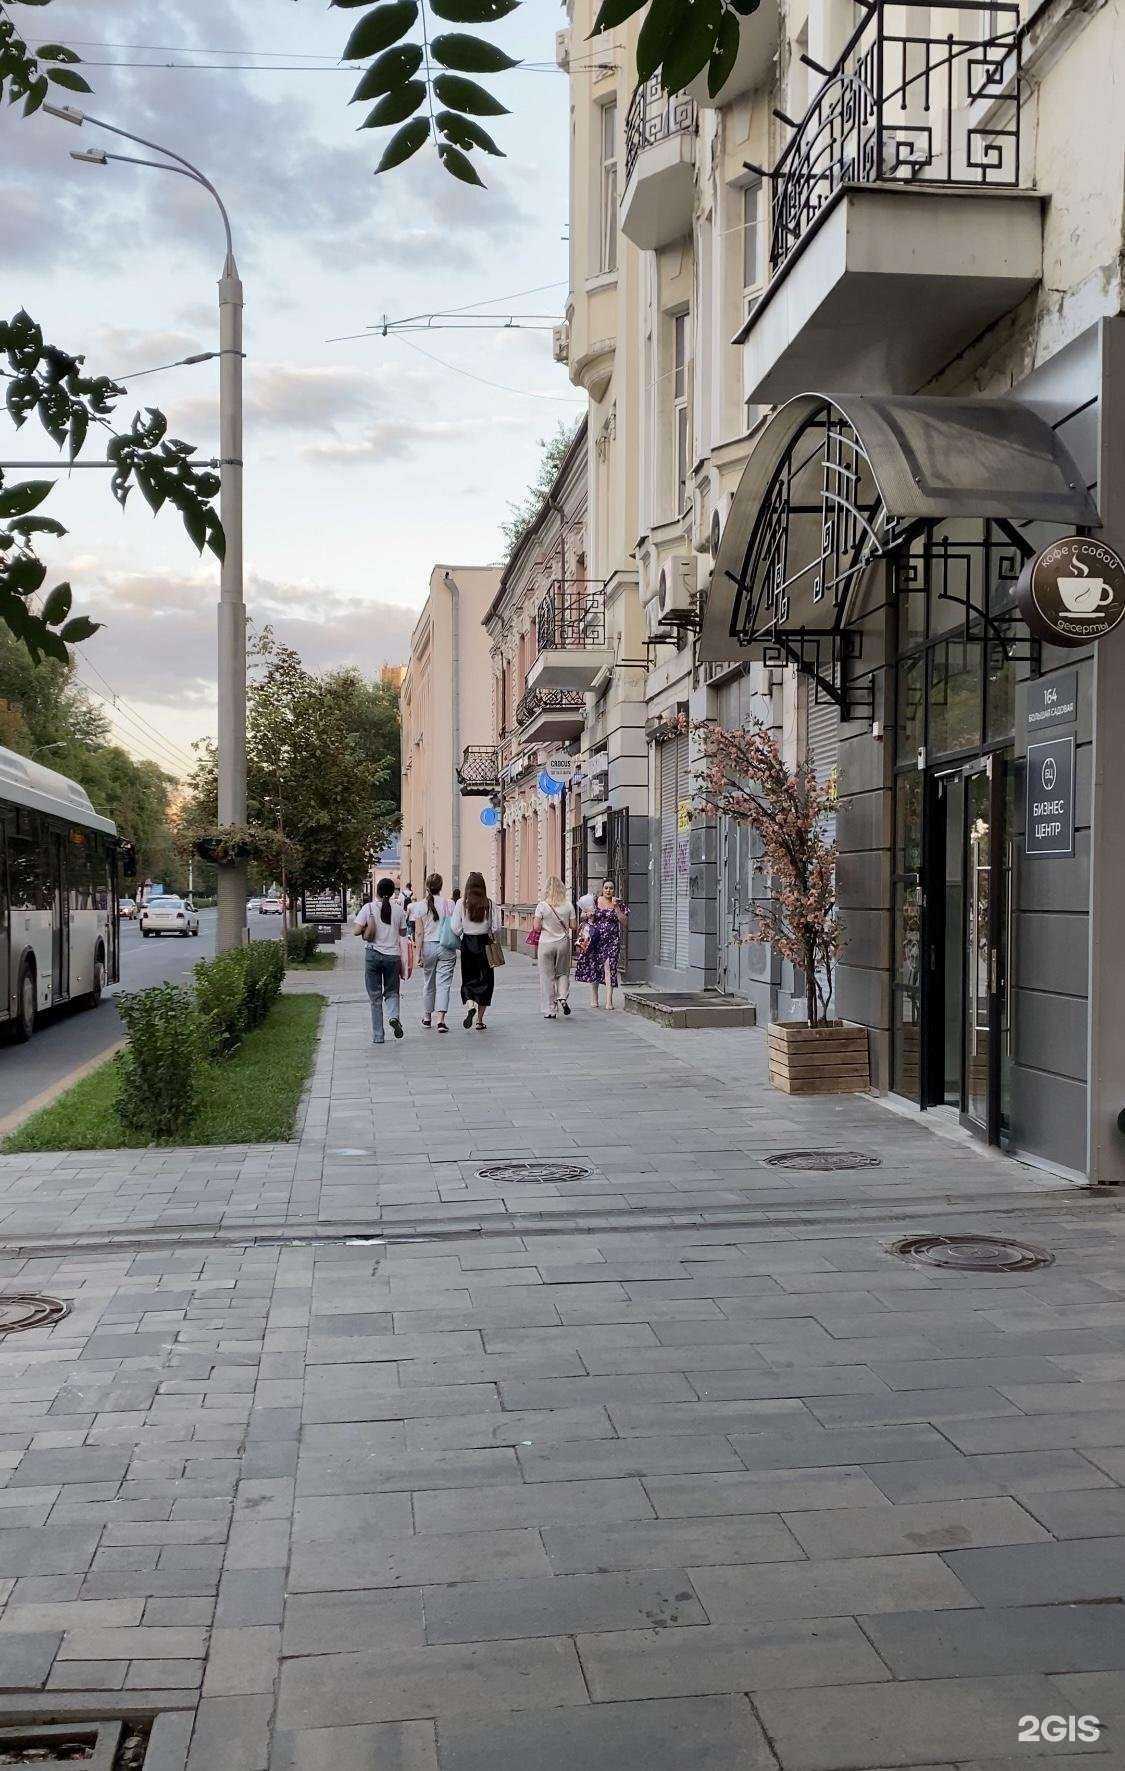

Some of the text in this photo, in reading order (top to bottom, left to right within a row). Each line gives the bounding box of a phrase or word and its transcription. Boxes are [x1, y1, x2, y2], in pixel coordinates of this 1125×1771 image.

[1041, 546, 1069, 568] кофе
[1081, 545, 1119, 568] собой
[1044, 688, 1058, 705] 164
[1033, 800, 1064, 816] БИЗНЕС
[1035, 822, 1061, 839] ЦЕНТР
